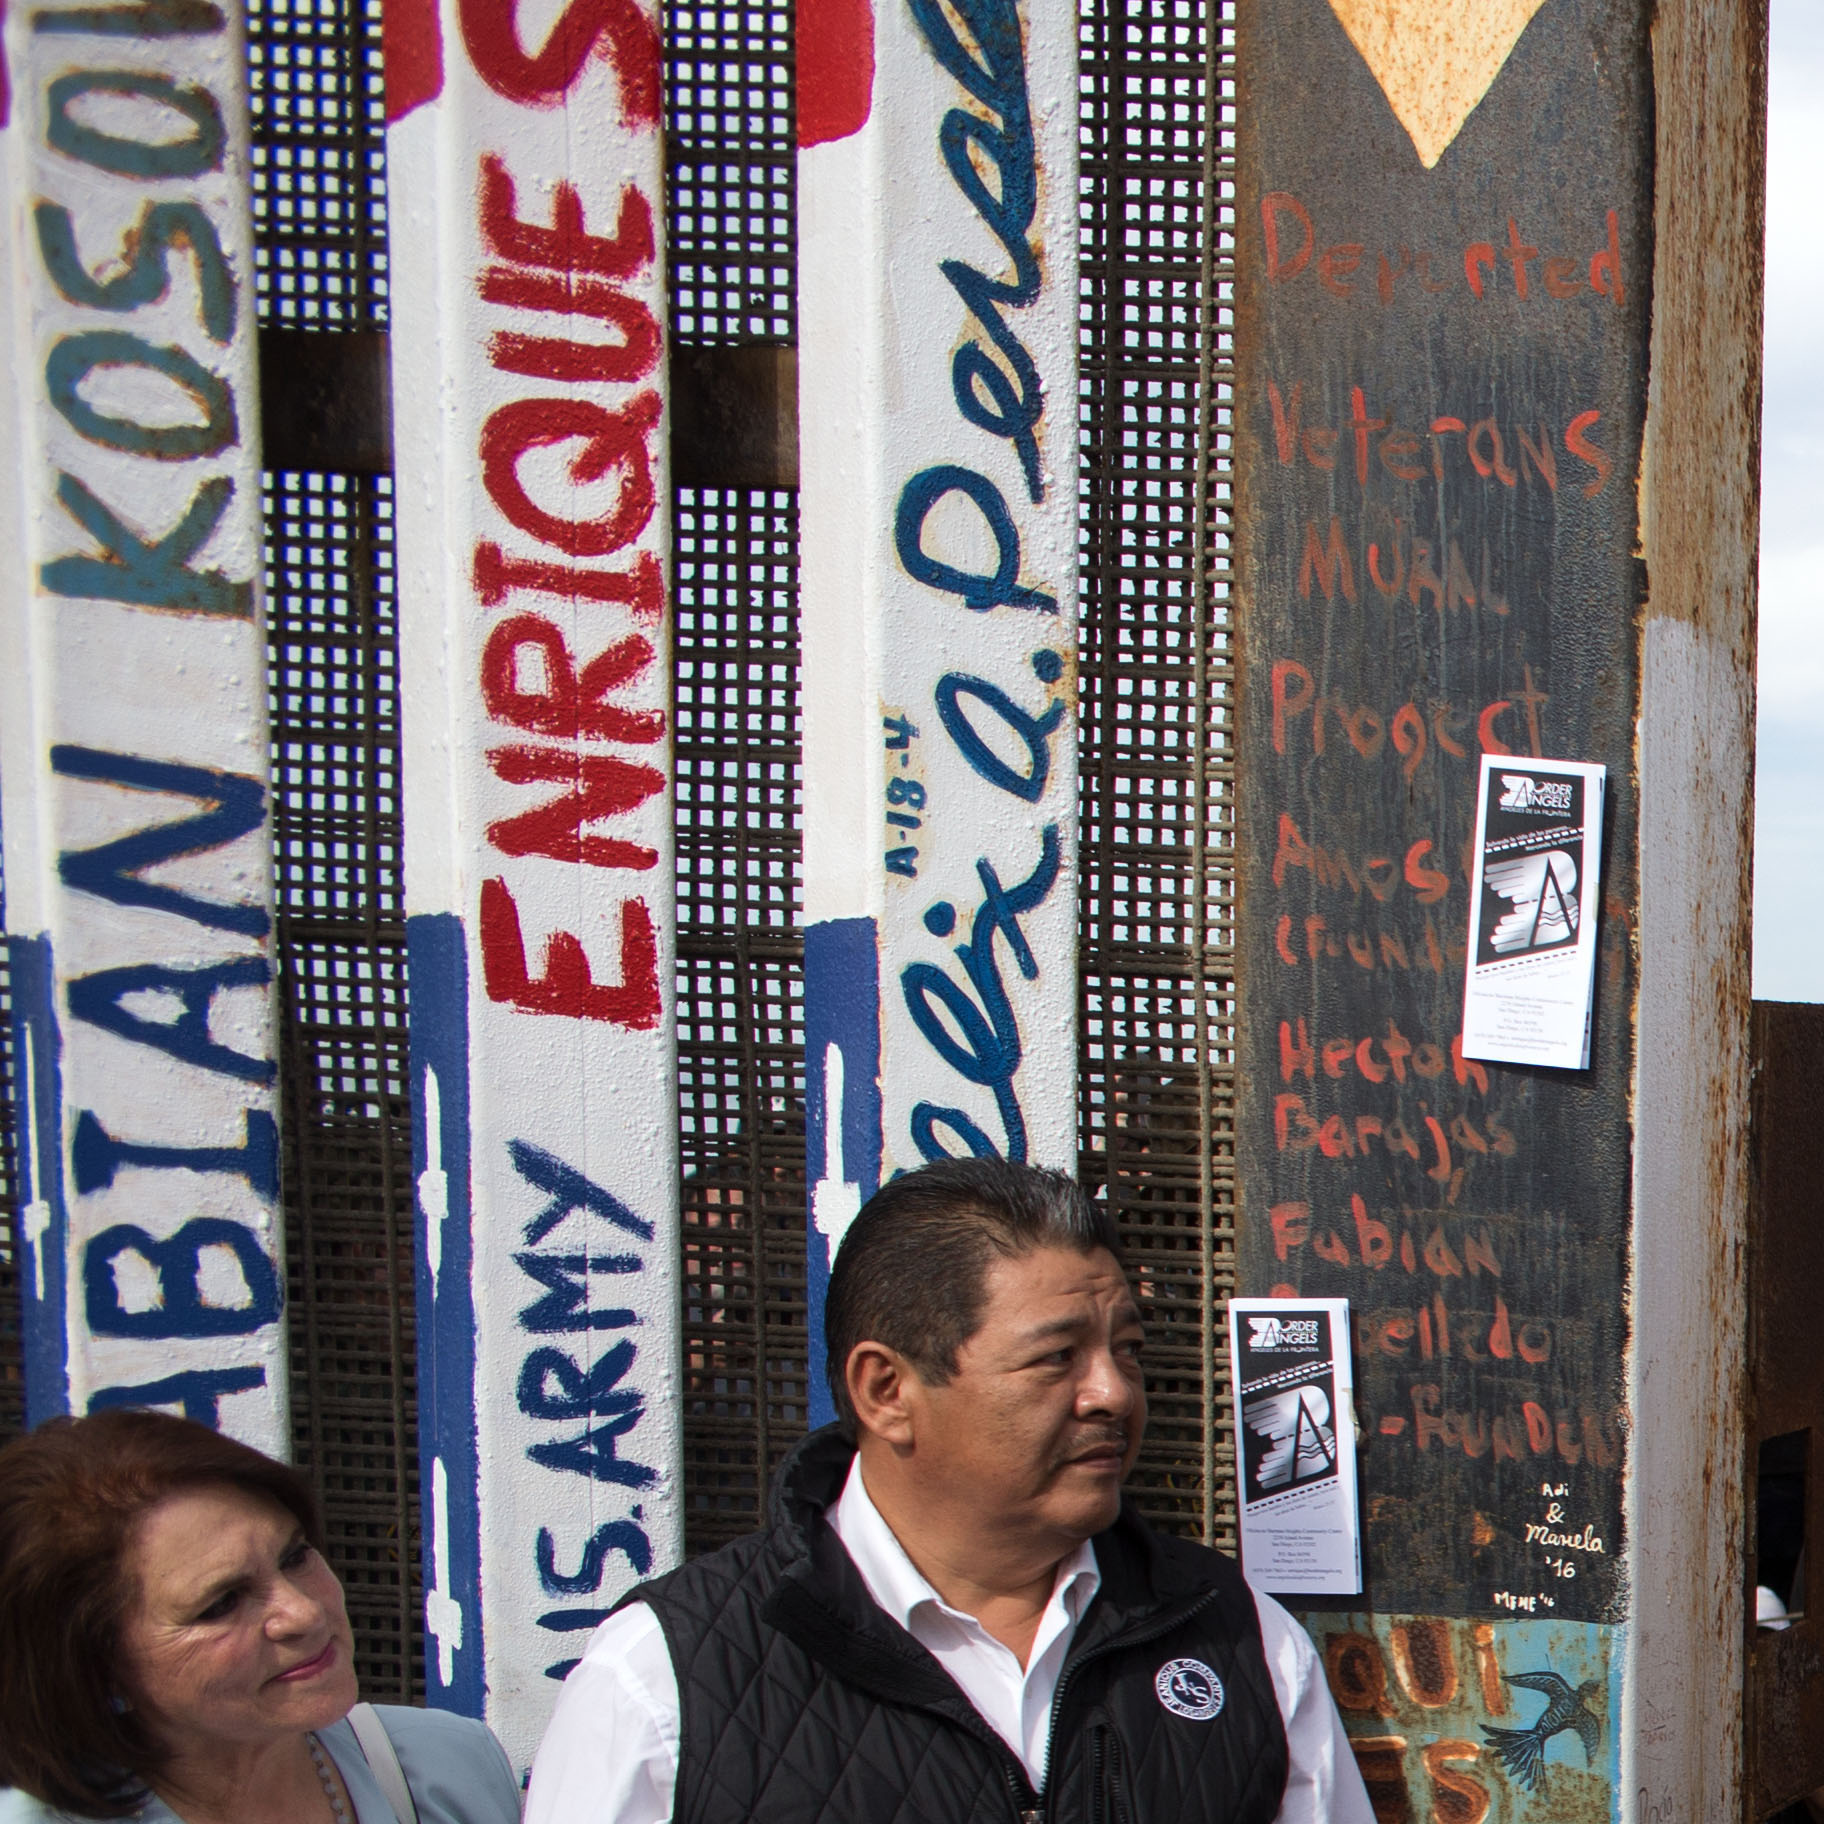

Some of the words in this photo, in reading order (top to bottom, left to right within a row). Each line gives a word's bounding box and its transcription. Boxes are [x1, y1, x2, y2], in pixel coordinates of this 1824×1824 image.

[33, 0, 255, 620] KOSO
[470, 150, 668, 1030] ENRIQUE
[507, 1138, 664, 1492] ARMY
[1545, 1502, 1566, 1525] &
